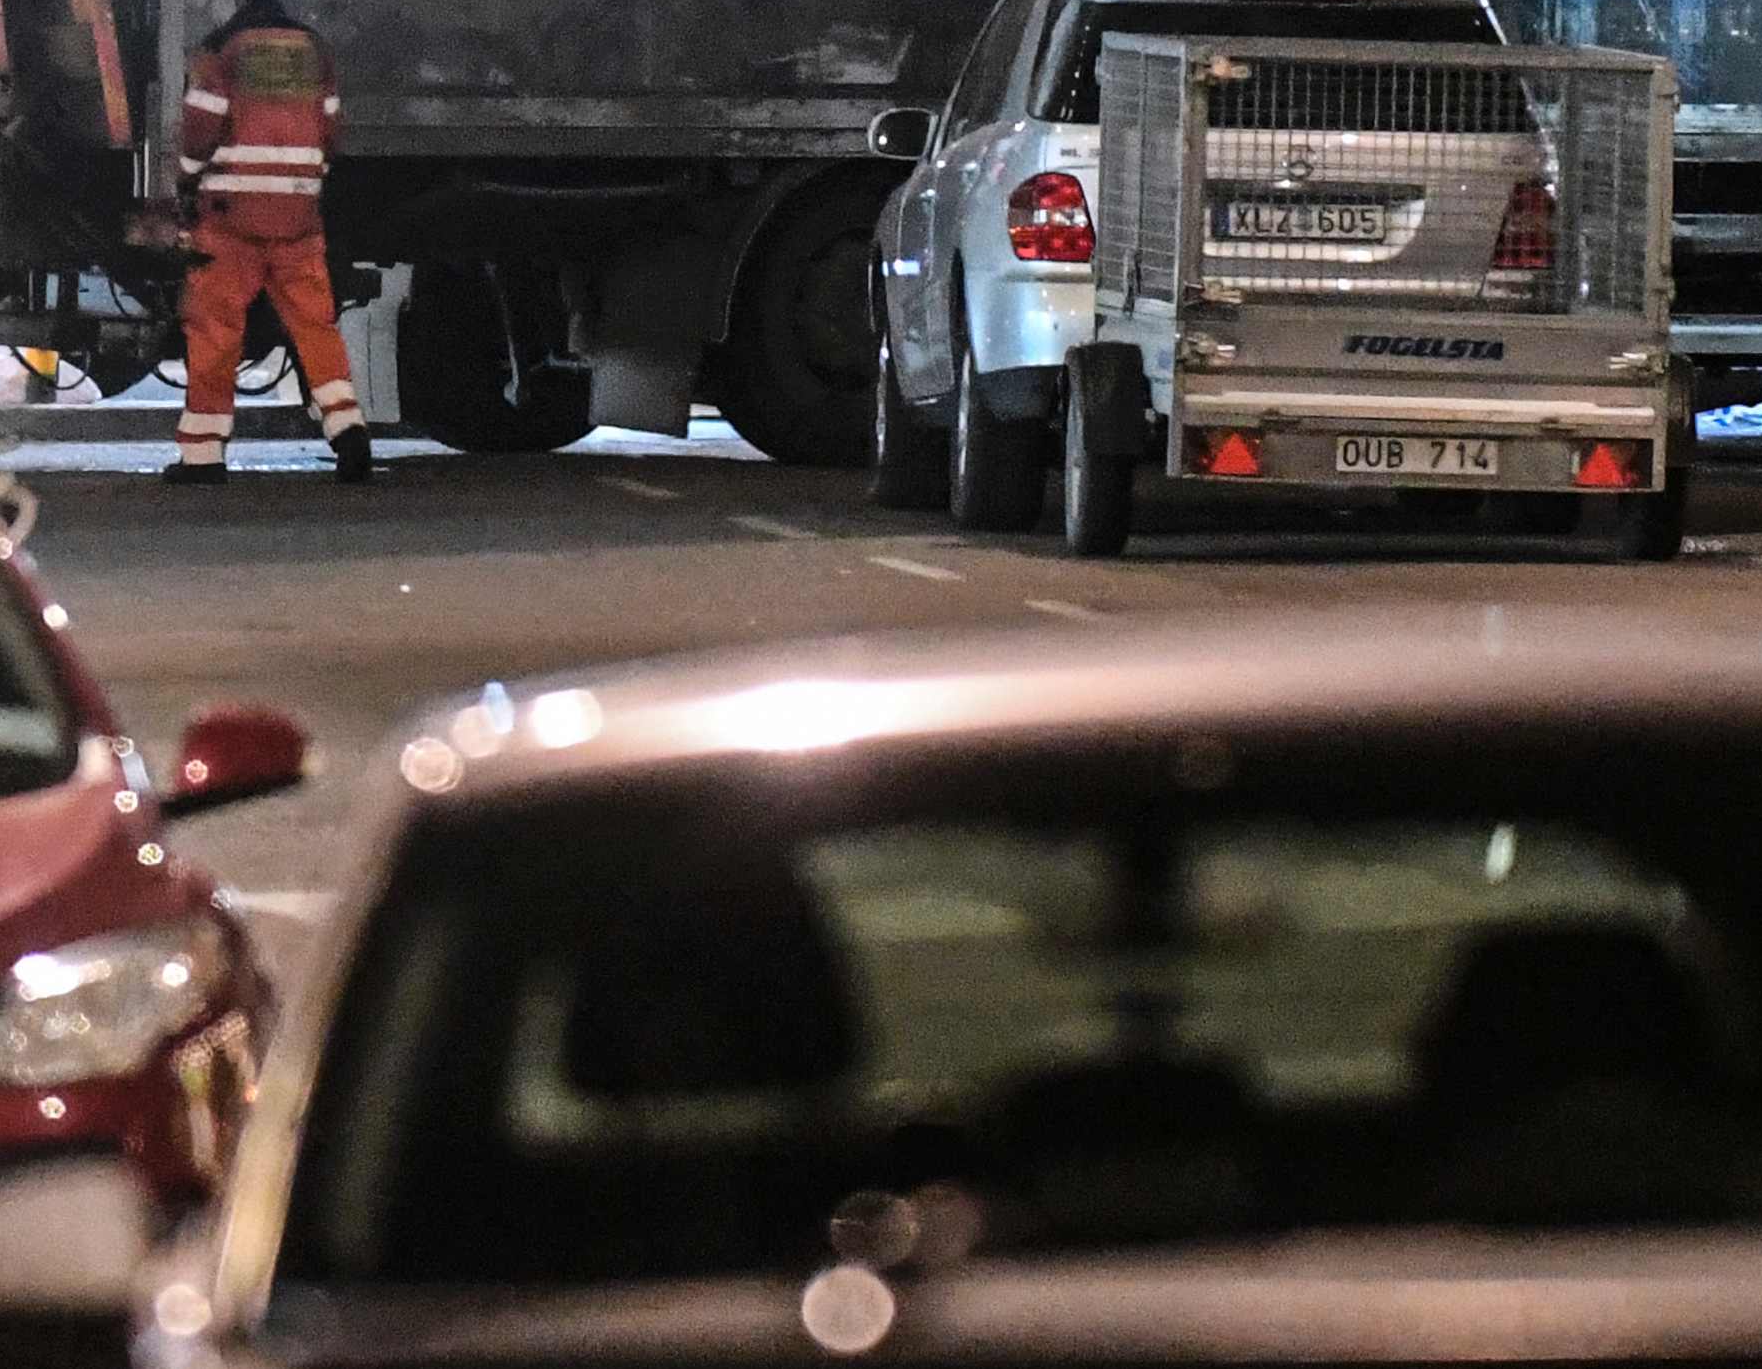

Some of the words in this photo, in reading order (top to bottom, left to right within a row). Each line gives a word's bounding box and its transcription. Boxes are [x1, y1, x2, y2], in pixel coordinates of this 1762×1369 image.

[1234, 207, 1293, 235] XLZ
[1317, 208, 1377, 235] 605
[1343, 334, 1504, 361] FOGELSTA
[1342, 439, 1406, 469] OUB
[1429, 441, 1492, 472] 714
